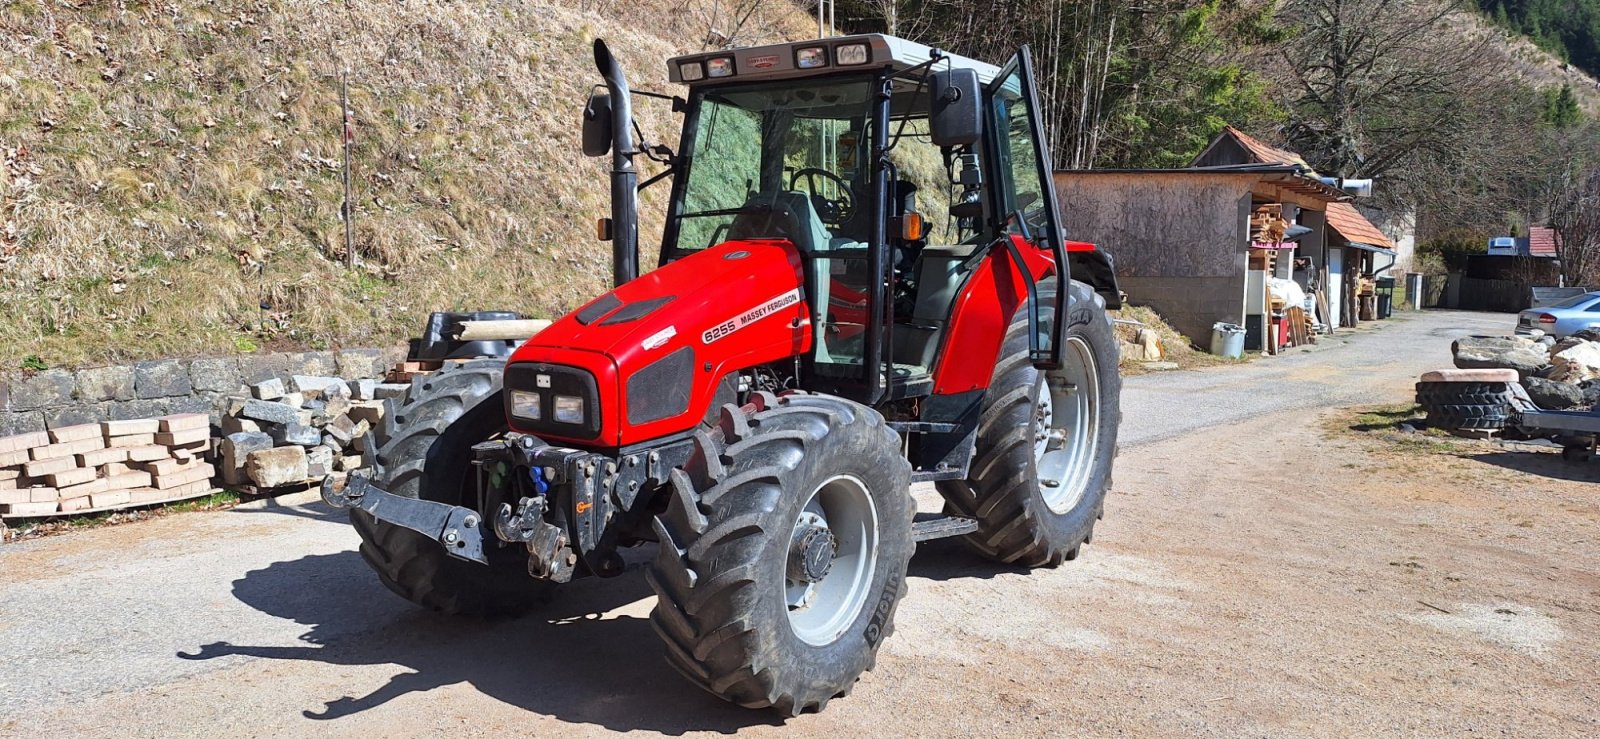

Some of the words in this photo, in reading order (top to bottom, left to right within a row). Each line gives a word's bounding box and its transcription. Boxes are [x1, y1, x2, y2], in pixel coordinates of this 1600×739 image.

[704, 320, 736, 342] 6255
[740, 307, 767, 325] MASSEY
[767, 293, 797, 312] FERGUSON
